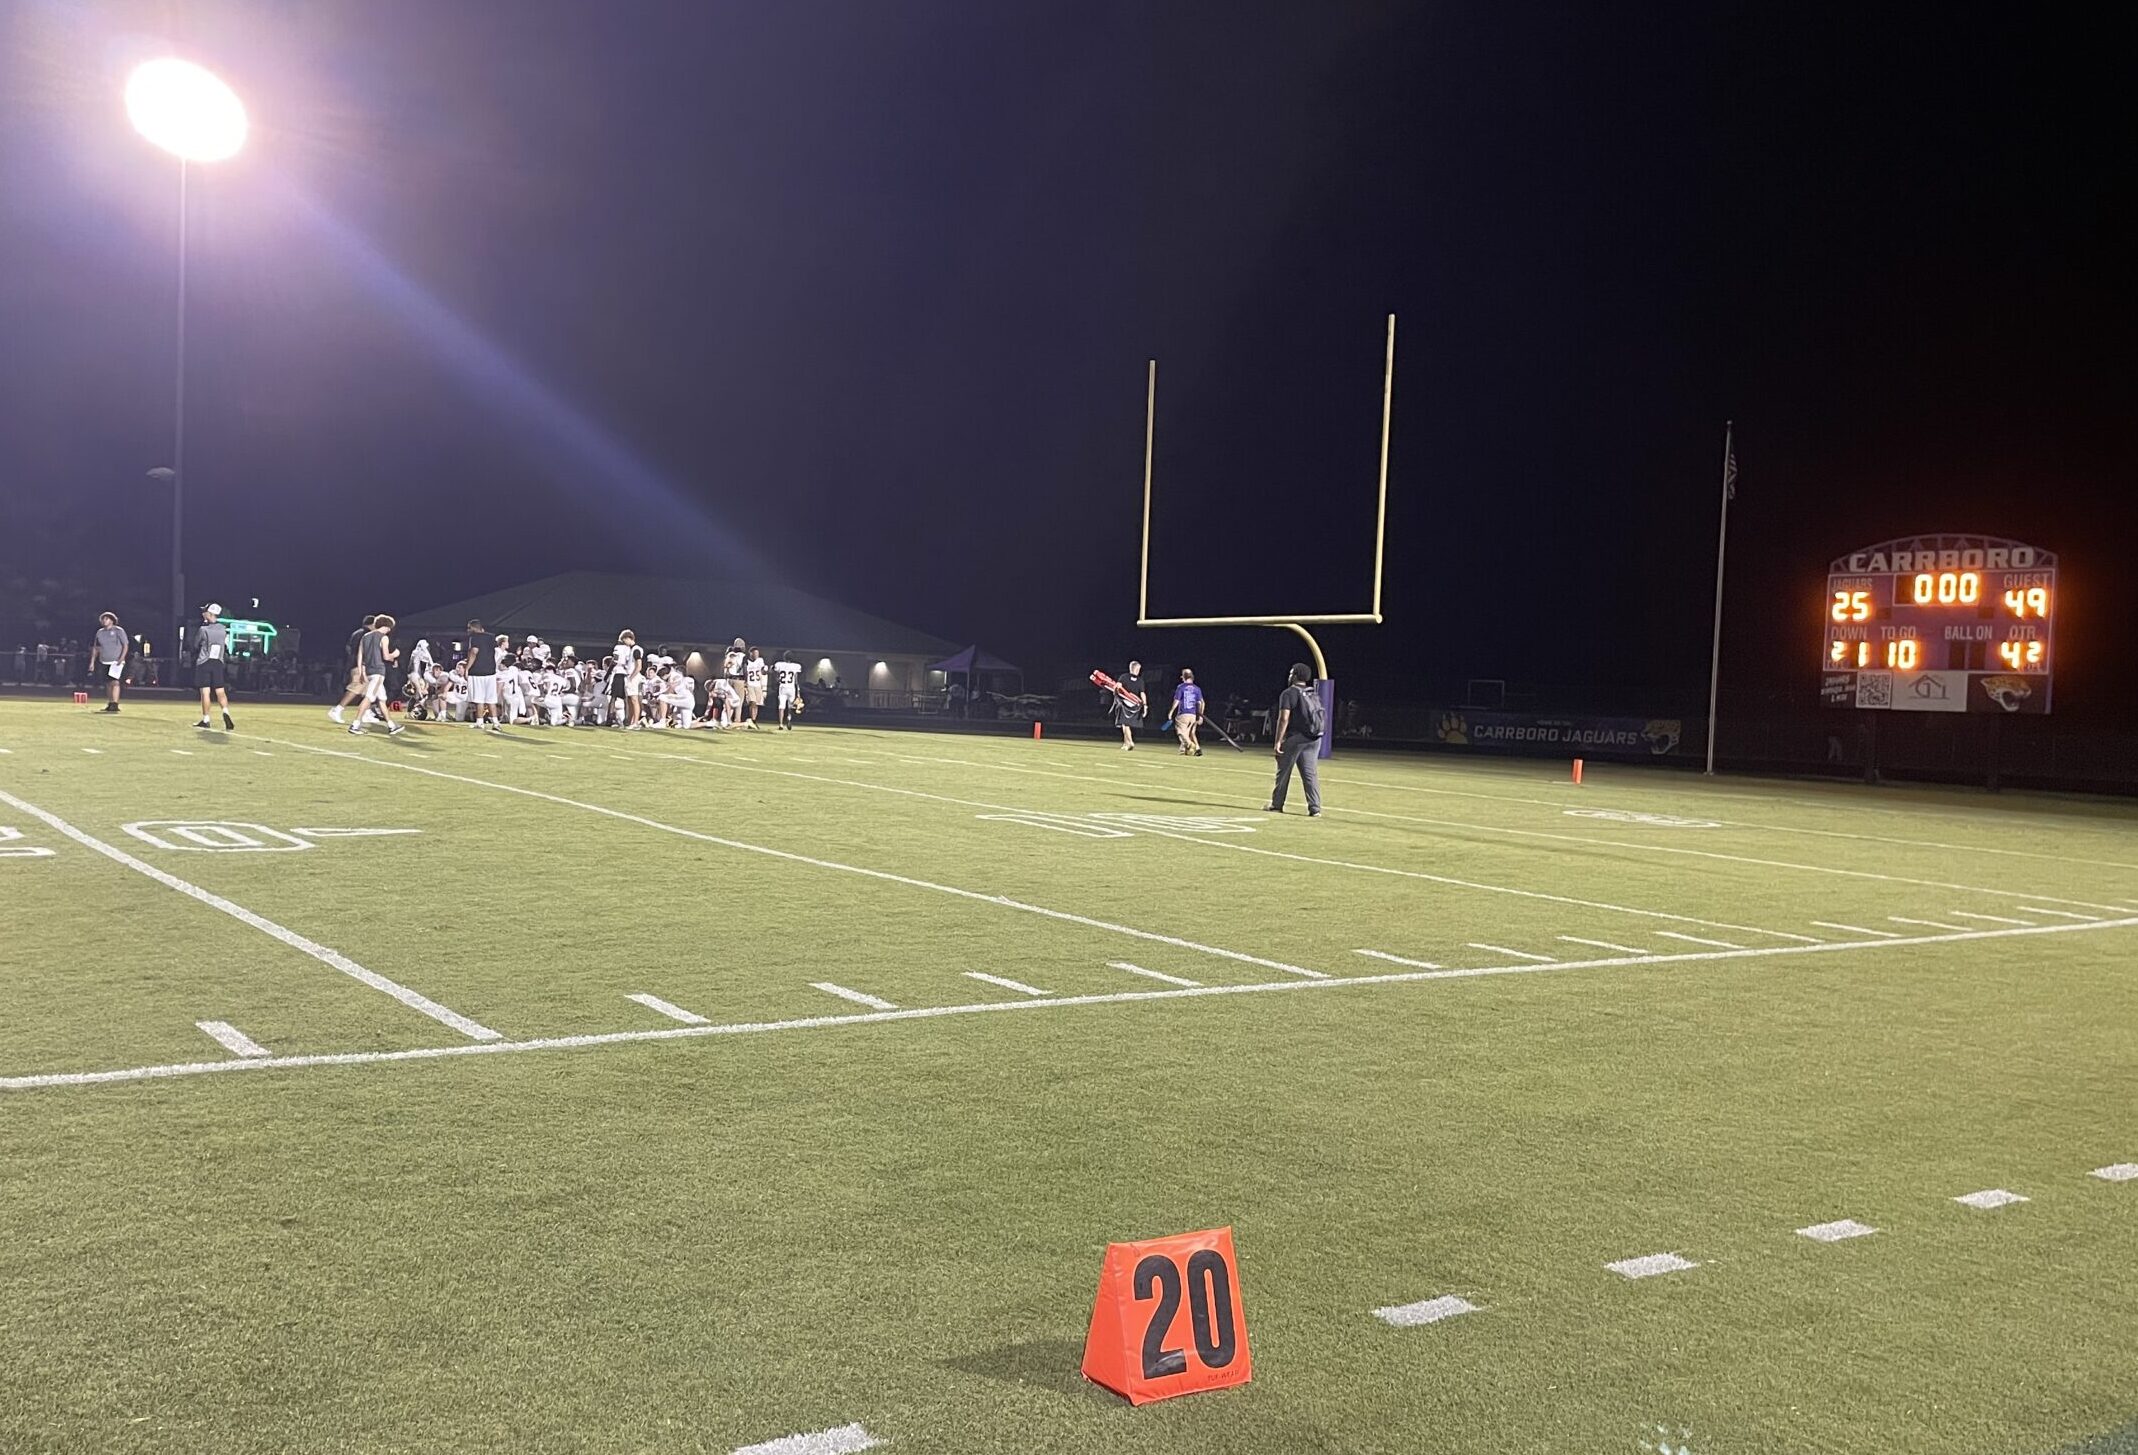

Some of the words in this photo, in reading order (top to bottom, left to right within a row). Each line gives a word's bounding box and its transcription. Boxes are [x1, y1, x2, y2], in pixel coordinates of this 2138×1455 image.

[1850, 547, 2035, 573] CARRBORO
[1831, 591, 1871, 621] 25
[2004, 587, 2047, 618] 49
[1831, 626, 1867, 640] DOWN
[1881, 626, 1896, 640] TO
[1899, 626, 1916, 640] GO
[1945, 626, 1972, 640] BALL
[1976, 626, 1993, 640] ON
[2009, 626, 2036, 640] QTR
[1858, 642, 1869, 667] 1
[1888, 640, 1917, 669] 10
[780, 671, 794, 684] 23
[1474, 725, 1558, 743] CARRBORO
[1562, 729, 1638, 746] JAGUARS
[1133, 1248, 1236, 1380] 20
